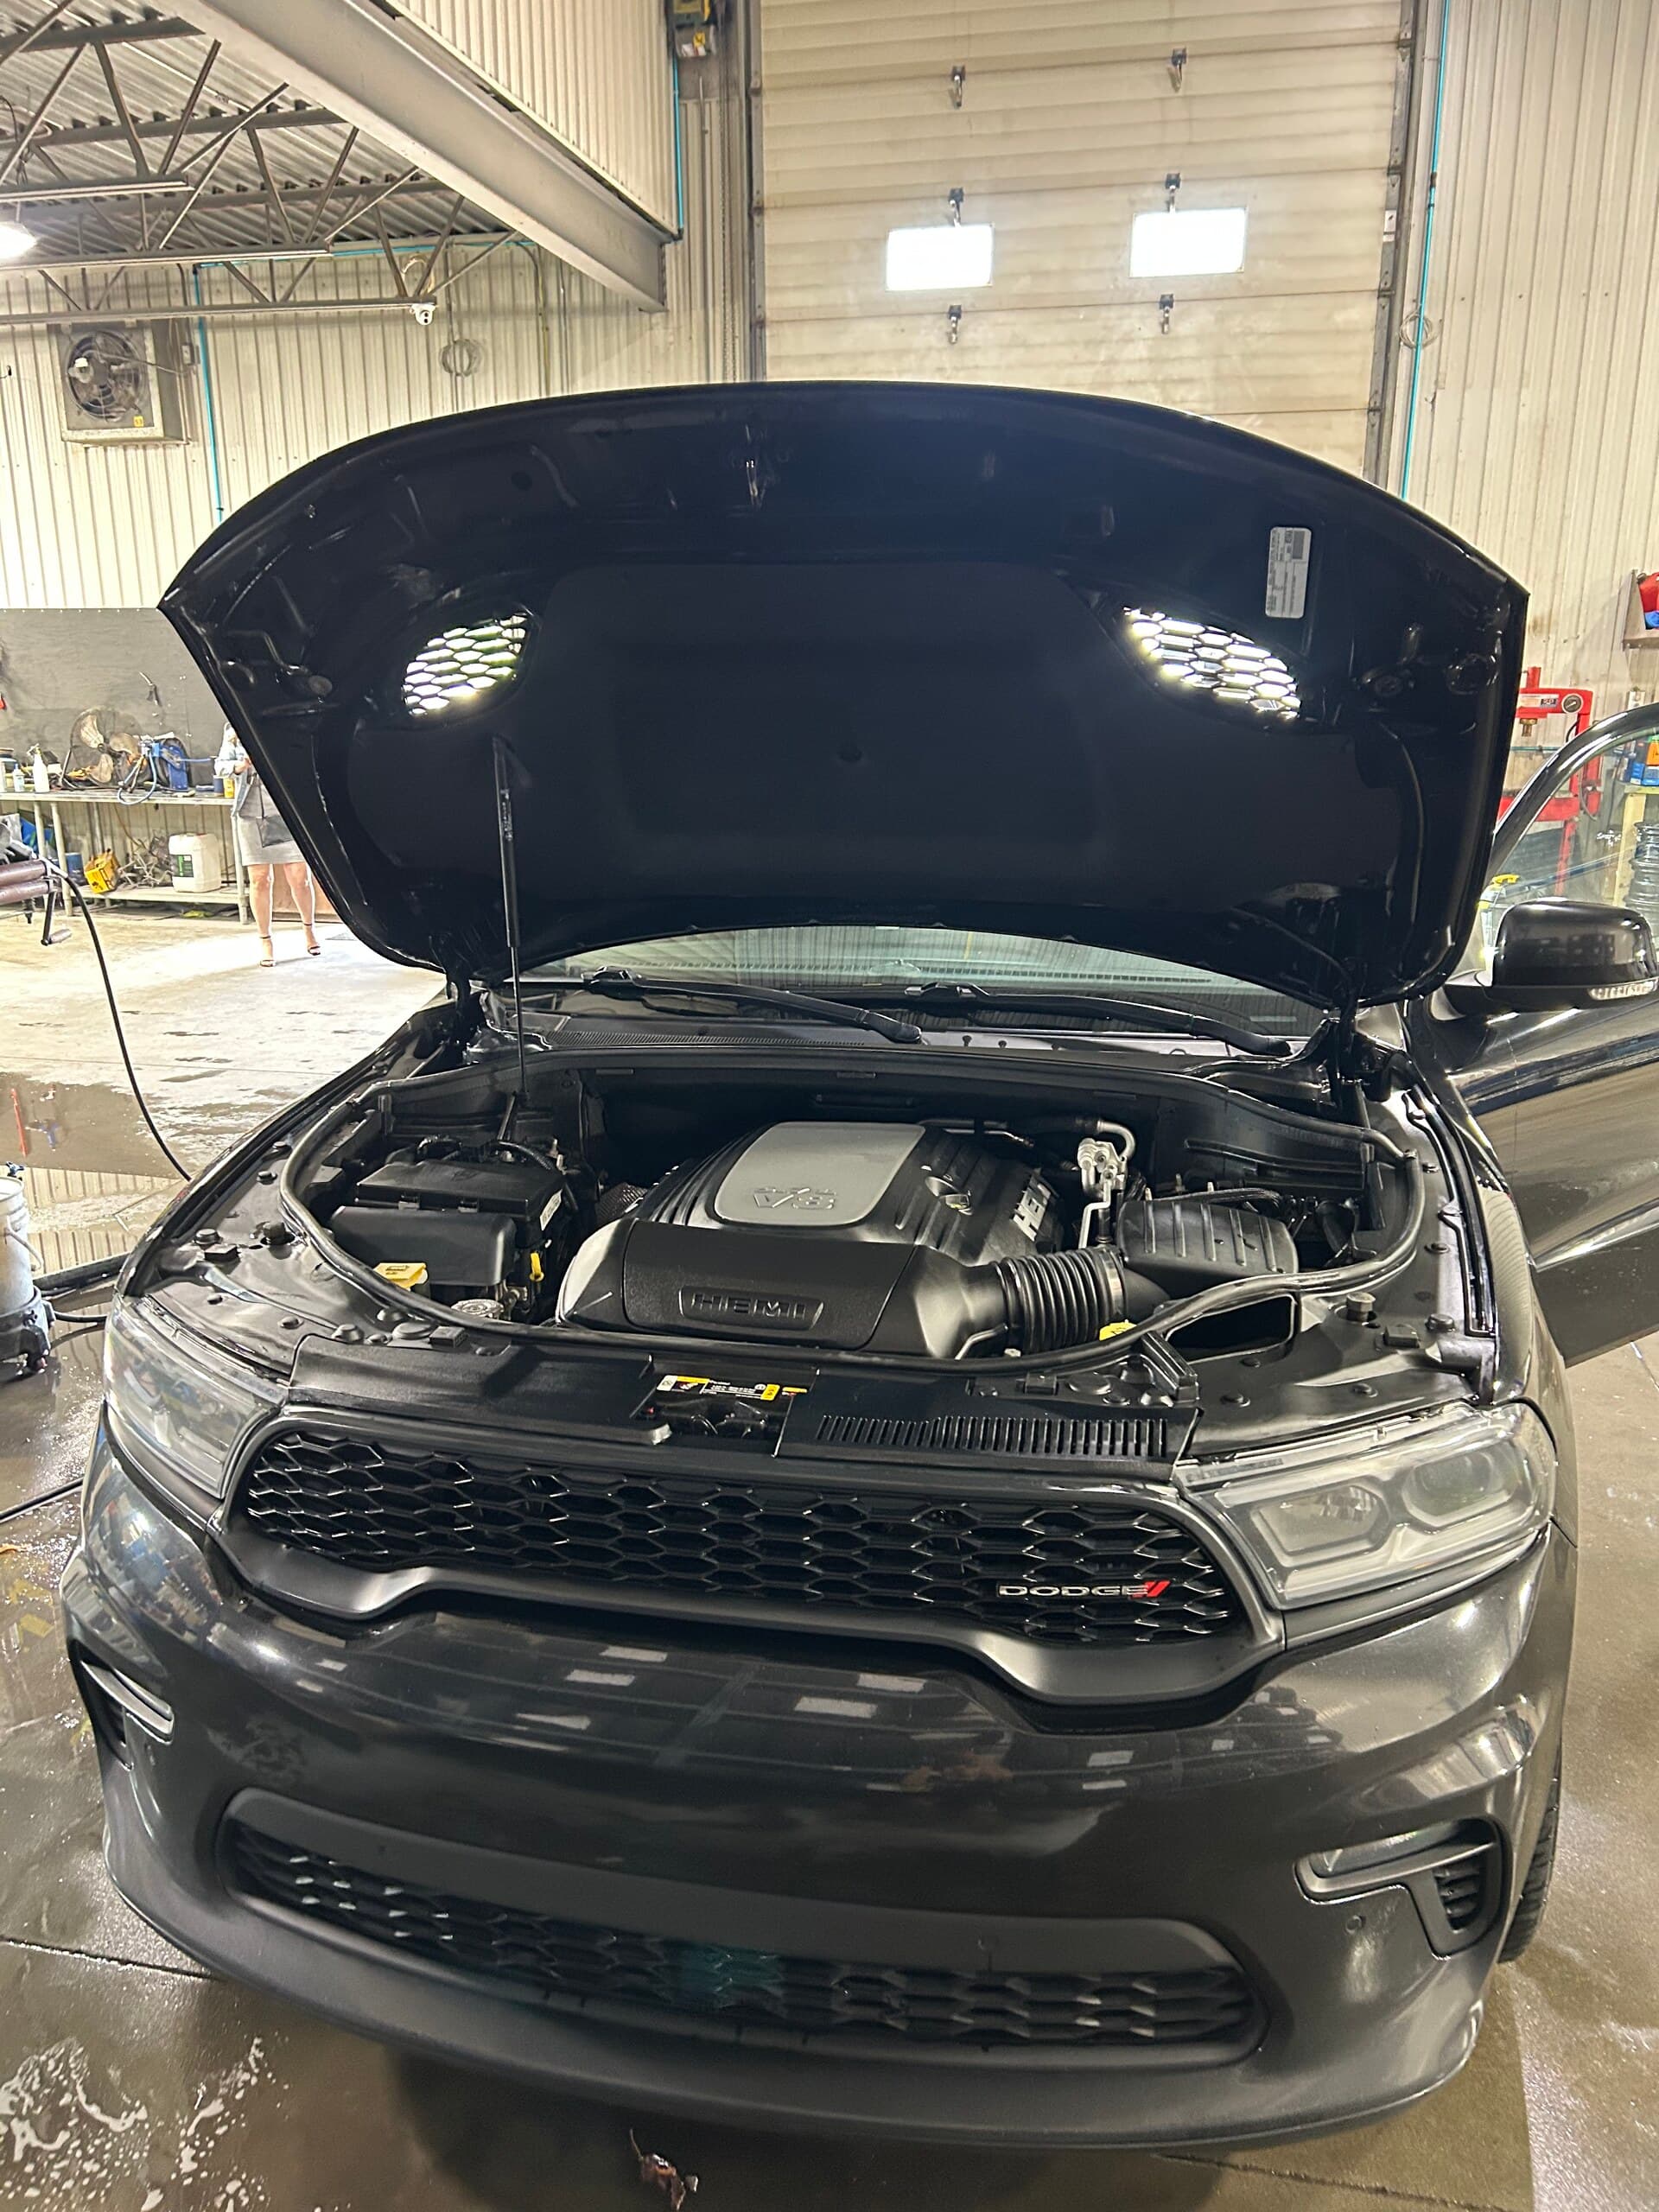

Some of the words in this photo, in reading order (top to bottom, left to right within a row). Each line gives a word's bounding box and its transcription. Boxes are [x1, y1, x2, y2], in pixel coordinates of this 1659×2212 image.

[753, 1186, 836, 1210] V8
[690, 1293, 806, 1320] HEMI
[998, 1585, 1149, 1598] DODGE
